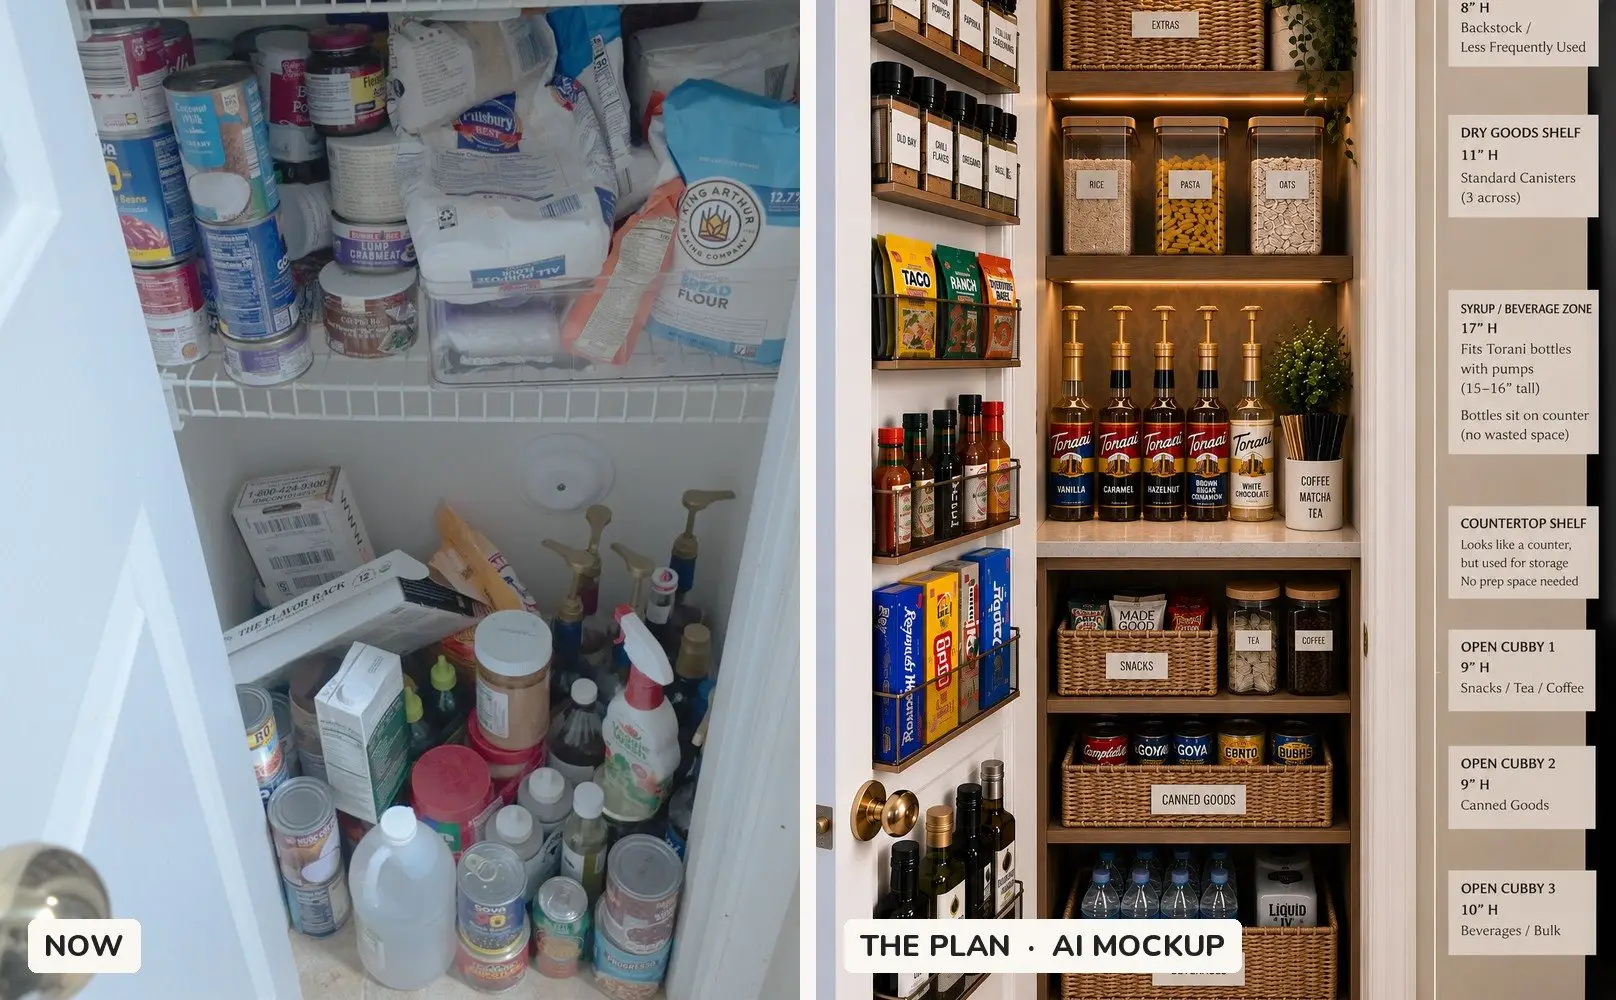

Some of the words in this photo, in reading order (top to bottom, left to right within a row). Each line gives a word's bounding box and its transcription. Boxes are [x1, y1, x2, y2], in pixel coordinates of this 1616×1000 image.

[1480, 2, 1490, 13] H
[1151, 20, 1180, 30] EXTRAS
[1461, 21, 1522, 34] Backstock
[1461, 41, 1486, 53] Less
[1489, 41, 1553, 55] Frequently
[1557, 41, 1586, 53] Used
[475, 126, 501, 140] BEST
[1461, 127, 1487, 139] DRY
[1490, 127, 1539, 139] GOODS
[1542, 127, 1581, 139] SHELF
[896, 133, 907, 144] OLD
[907, 136, 917, 148] BAY
[1488, 149, 1498, 161] H
[1461, 172, 1516, 184] Standard
[1519, 172, 1576, 184] Canisters
[1089, 180, 1104, 189] RICE
[1180, 180, 1201, 189] PASTA
[1279, 180, 1296, 189] OATS
[119, 194, 147, 204] Beans
[1461, 191, 1474, 205] (3
[1477, 191, 1521, 205] across)
[681, 186, 708, 216] KING
[711, 186, 755, 225] ARTHUR
[361, 241, 389, 251] LUMP
[705, 236, 748, 261] COMPANY
[350, 249, 400, 261] CRABMEAT
[901, 269, 931, 288] TACO
[950, 276, 977, 292] RANCH
[677, 288, 729, 310] FLOUR
[1460, 303, 1495, 314] SYRUP
[1504, 303, 1560, 314] BEVERAGE
[1562, 303, 1592, 314] ZONE
[1487, 322, 1497, 334] H
[1461, 343, 1483, 355] Fits
[1486, 343, 1526, 355] Torani
[1530, 343, 1572, 355] bottles
[1461, 363, 1488, 374] with
[1492, 365, 1534, 377] pumps
[1516, 382, 1540, 396] tall)
[1461, 409, 1502, 421] Bottles
[1505, 409, 1520, 421] sit
[1523, 411, 1539, 421] on
[1542, 411, 1589, 421] counter
[1461, 429, 1481, 442] (no
[1485, 429, 1527, 440] wasted
[1530, 429, 1570, 442] space)
[1242, 482, 1262, 491] WHITE
[1301, 475, 1330, 487] COFFEE
[1057, 485, 1086, 494] VANILLA
[1103, 485, 1134, 494] CARAMEL
[1147, 485, 1180, 494] HAZELNUT
[1235, 490, 1269, 499] CHOCOLATE
[1299, 491, 1332, 503] MATCHA
[1308, 508, 1324, 519] TEA
[1461, 518, 1547, 529] COUNTERTOP
[1549, 518, 1587, 529] SHELF
[1461, 539, 1493, 550] Looks
[1496, 539, 1515, 550] like
[1518, 542, 1524, 550] a
[1527, 540, 1572, 551] counter,
[1461, 557, 1479, 568] but
[1482, 557, 1507, 568] used
[1510, 557, 1526, 568] for
[1529, 558, 1569, 570] storage
[1461, 576, 1477, 587] No
[1479, 578, 1504, 589] prep
[1507, 578, 1537, 589] space
[1540, 576, 1579, 587] needed
[238, 619, 263, 637] THE
[265, 600, 309, 625] FLAVOR
[311, 580, 346, 602] RACK
[1119, 610, 1155, 621] MADE
[1118, 620, 1155, 631] GOOD
[1247, 636, 1260, 645] TEA
[1302, 636, 1326, 645] COFFEE
[1461, 641, 1497, 652] OPEN
[1501, 641, 1545, 652] CUBBY
[1549, 641, 1555, 652] 1
[1120, 660, 1154, 672] SNACKS
[1480, 662, 1490, 673] H
[1461, 682, 1502, 693] Snacks
[1513, 682, 1535, 693] Tea
[1546, 682, 1584, 693] Coffee
[1177, 743, 1208, 756] GOYA
[1461, 758, 1497, 769] OPEN
[1501, 758, 1545, 769] CUBBY
[1548, 758, 1556, 769] 2
[1480, 779, 1490, 790] H
[1162, 794, 1200, 806] CANNED
[1203, 794, 1236, 806] GOODS
[1461, 799, 1507, 811] Canned
[1510, 799, 1550, 811] Goods
[1461, 883, 1497, 894] OPEN
[1501, 883, 1545, 894] CUBBY
[1548, 883, 1556, 894] 3
[1488, 904, 1498, 916] H
[1461, 925, 1521, 939] Beverages
[1534, 925, 1561, 936] Bulk
